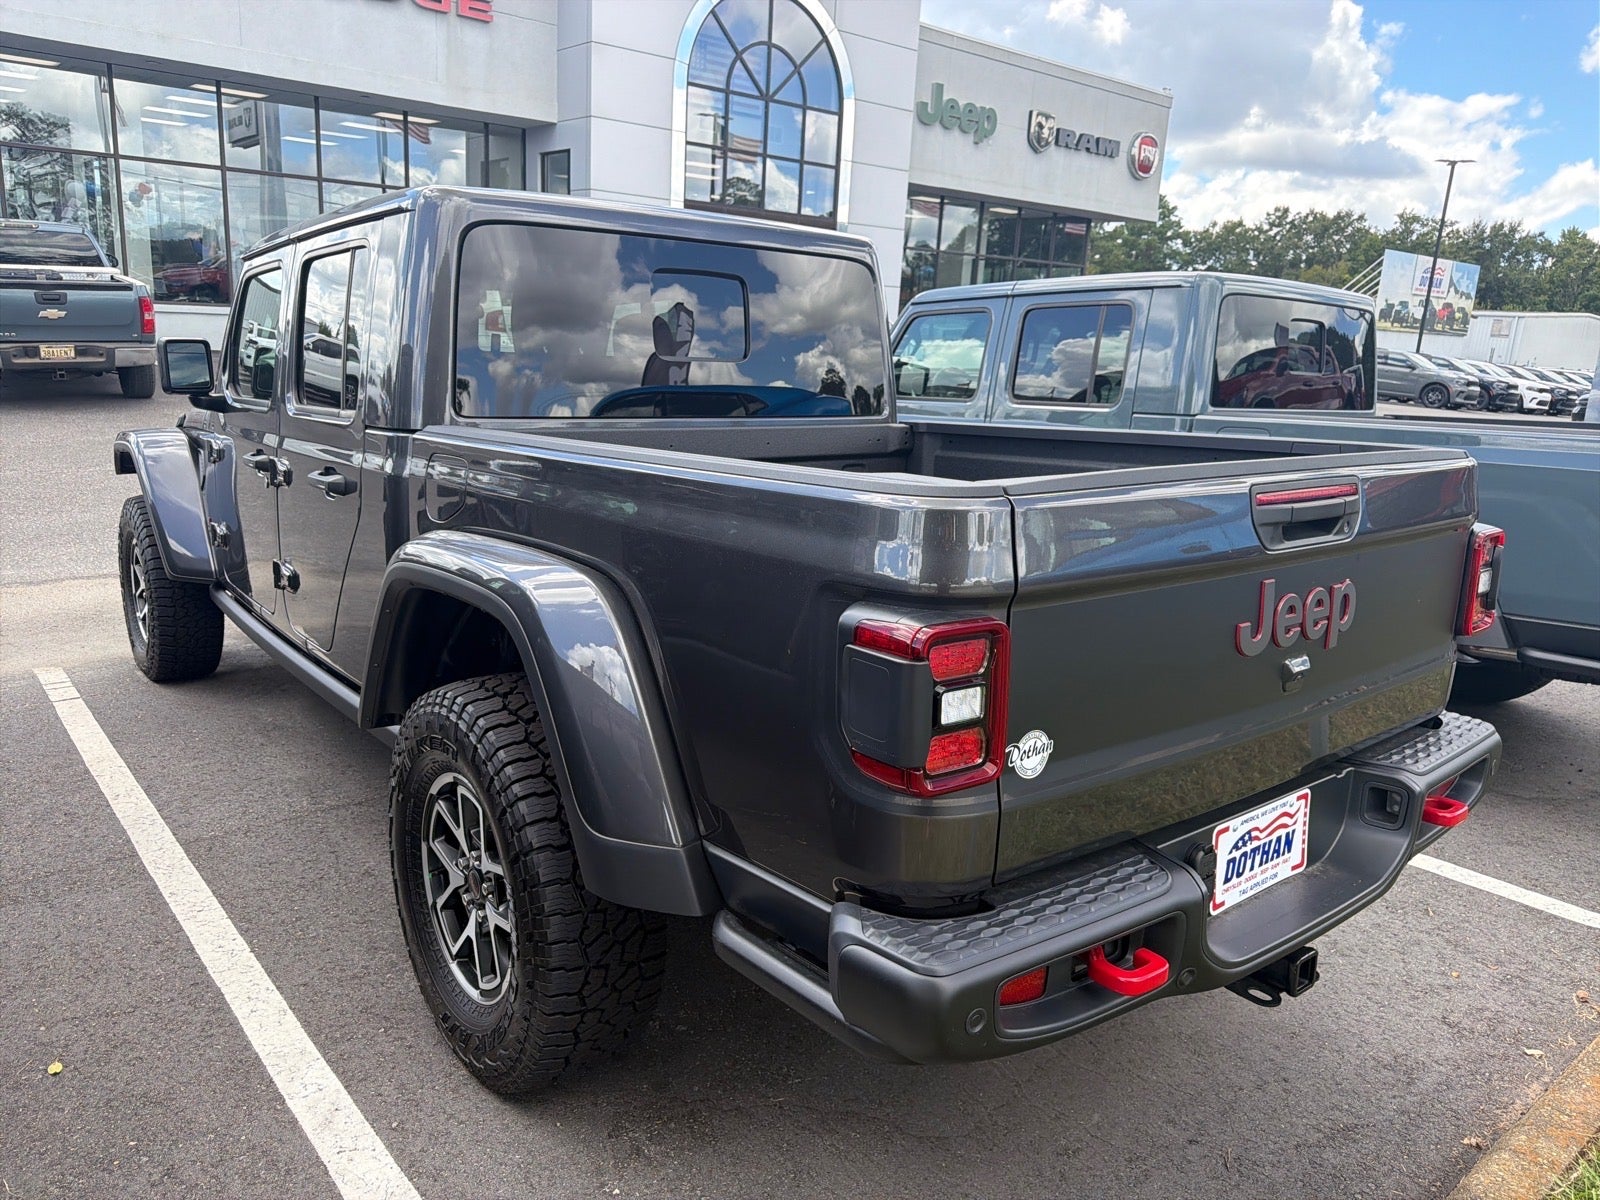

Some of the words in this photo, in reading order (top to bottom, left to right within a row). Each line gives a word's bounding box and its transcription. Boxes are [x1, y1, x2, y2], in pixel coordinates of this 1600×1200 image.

[917, 82, 998, 145] Jeep
[1055, 127, 1121, 158] RAM
[1235, 579, 1357, 657] Jeep
[1006, 740, 1053, 765] Dothan
[1222, 828, 1296, 886] DOTHAN
[1239, 886, 1249, 897] TAG
[1249, 876, 1269, 893] APPLIED
[1268, 871, 1279, 883] FOR
